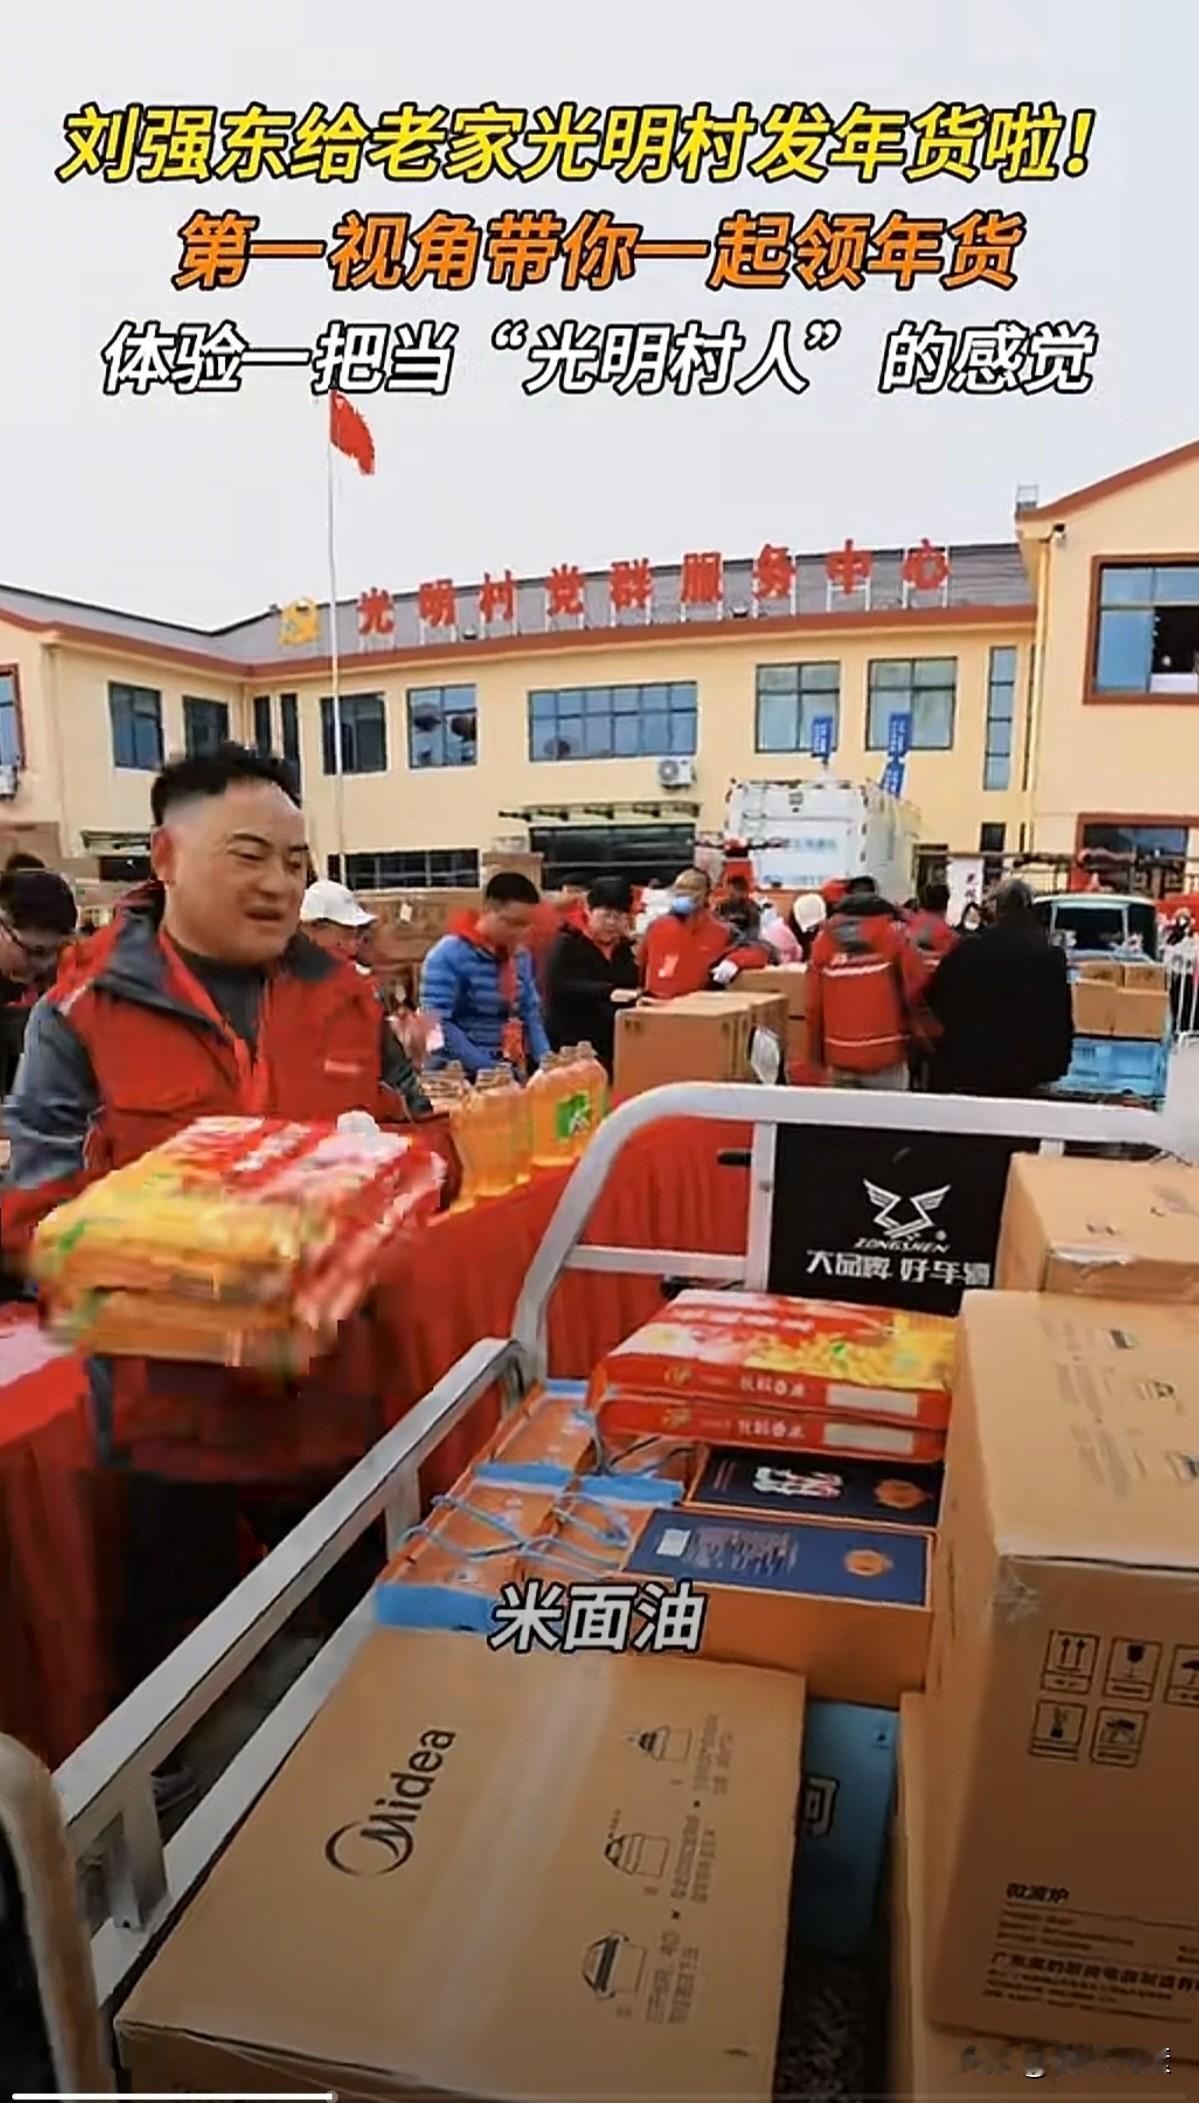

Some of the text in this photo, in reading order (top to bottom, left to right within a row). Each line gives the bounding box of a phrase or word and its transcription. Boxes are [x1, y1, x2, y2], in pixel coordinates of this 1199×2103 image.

[355, 537, 950, 636] 光明村党群服务中心
[325, 1729, 456, 1877] Midea
